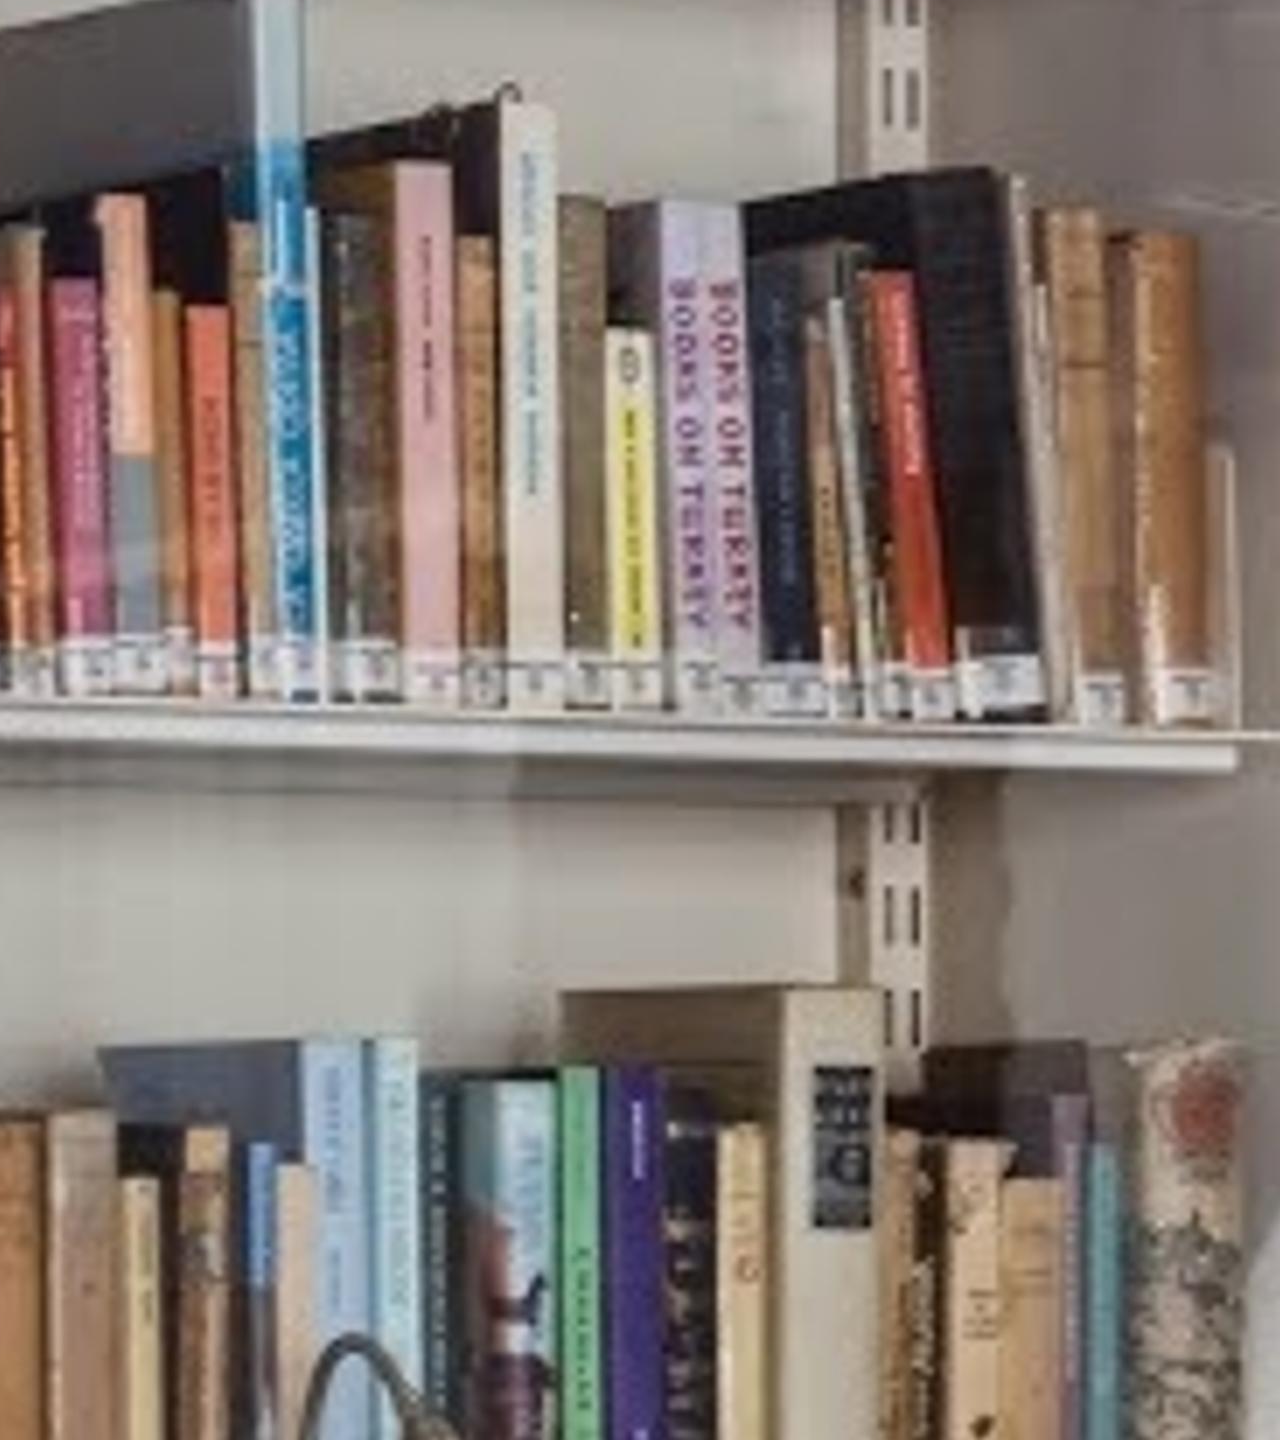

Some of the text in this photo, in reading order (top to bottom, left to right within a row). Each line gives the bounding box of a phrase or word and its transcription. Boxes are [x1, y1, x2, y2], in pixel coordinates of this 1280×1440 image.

[666, 279, 711, 631] BOOKS ON TURKEY
[710, 279, 757, 633] BOOKS ON TURKEY
